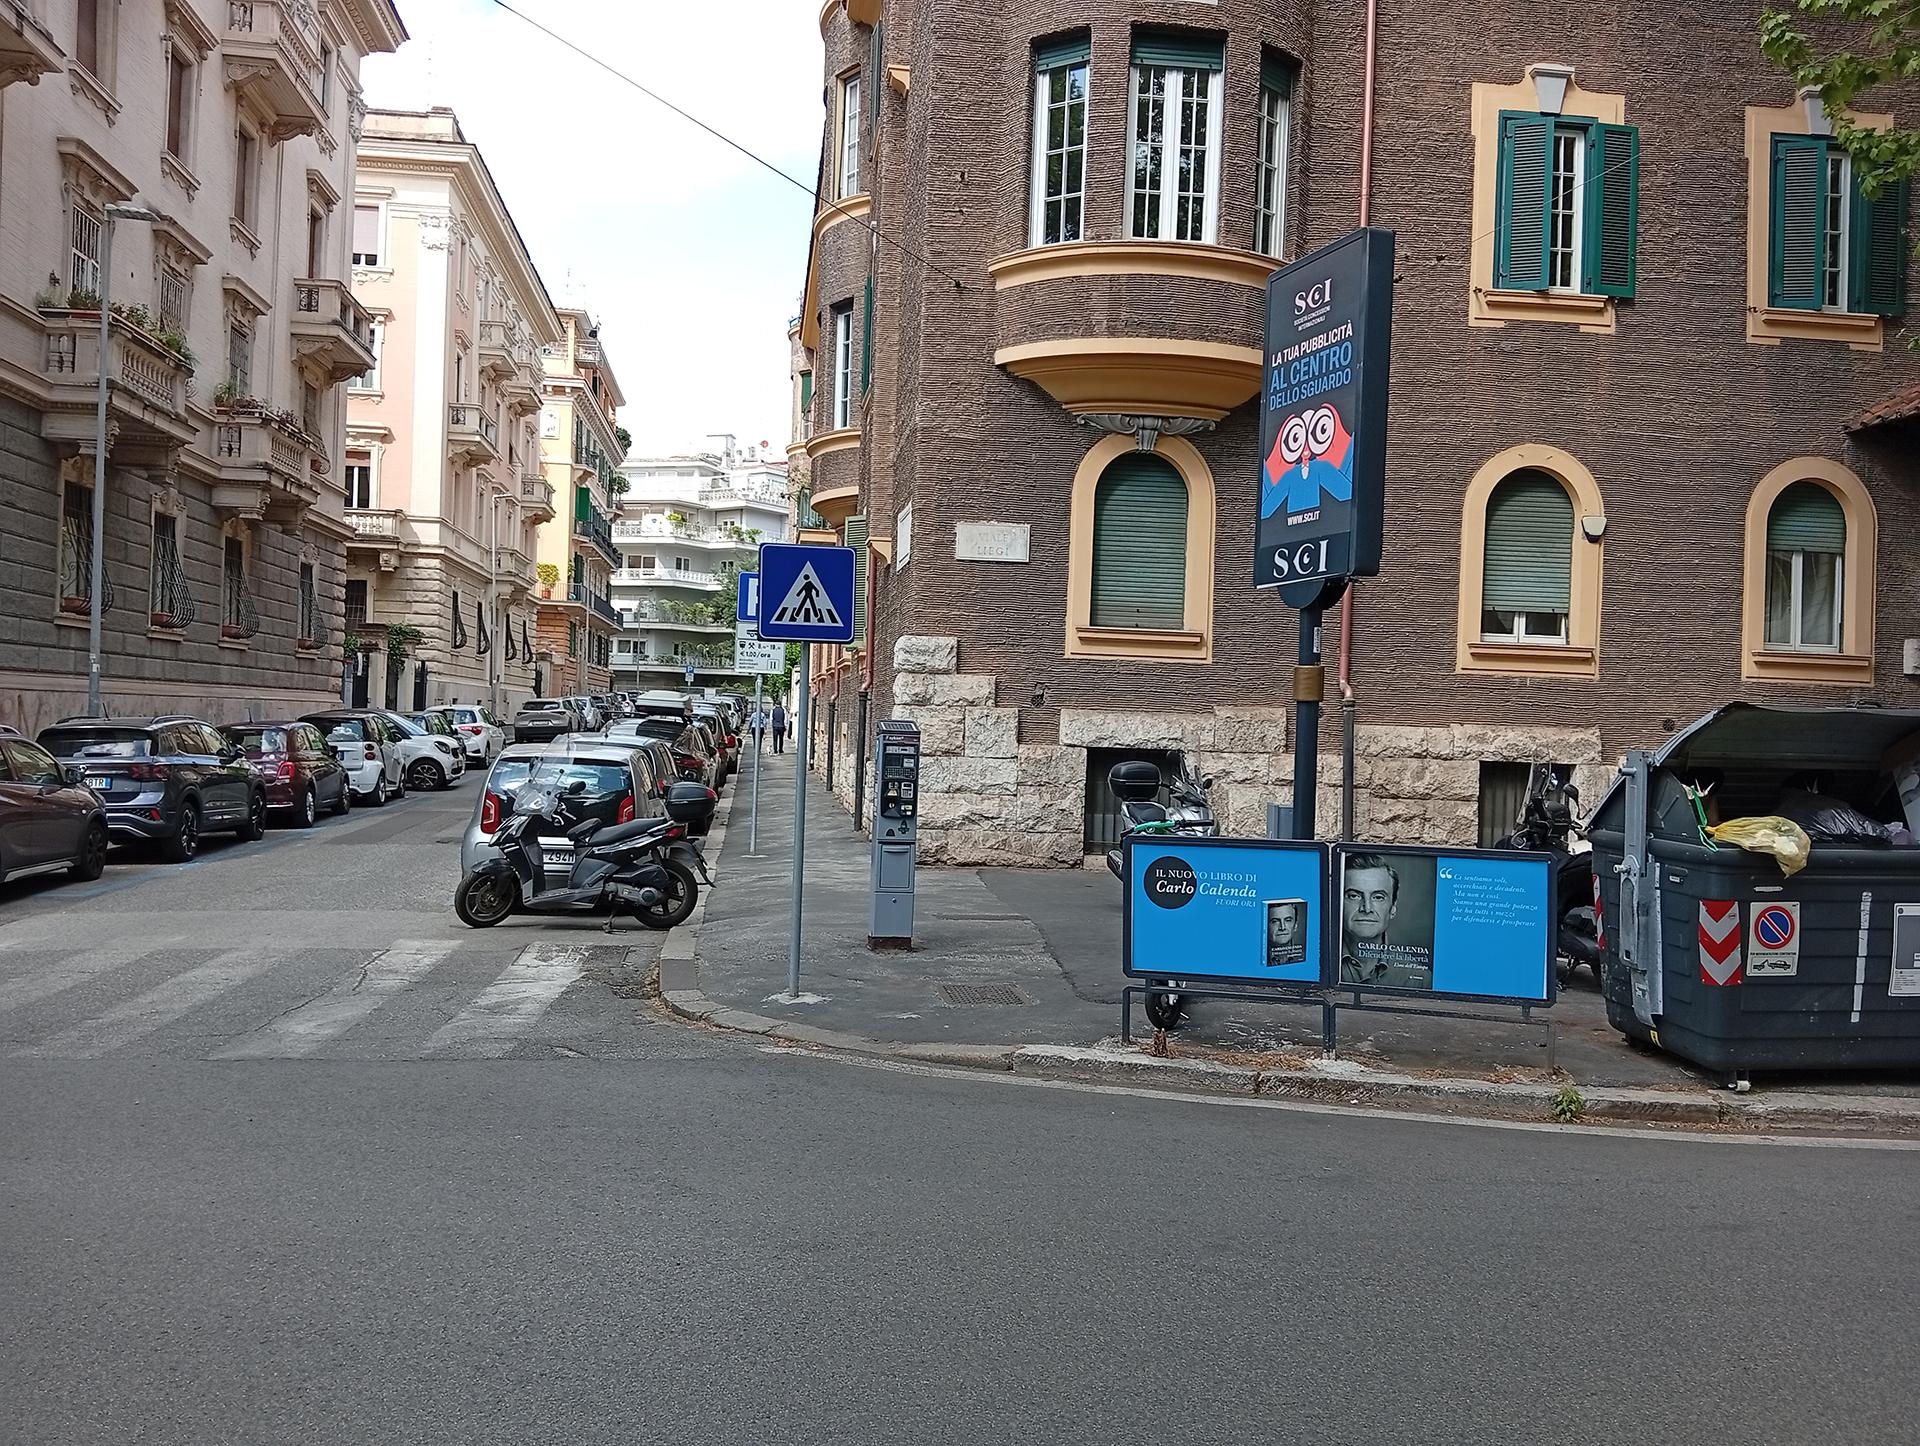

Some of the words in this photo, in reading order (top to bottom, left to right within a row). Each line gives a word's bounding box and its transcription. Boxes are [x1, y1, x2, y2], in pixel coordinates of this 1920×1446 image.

[1295, 278, 1332, 315] SCI
[1272, 352, 1282, 367] LA
[1283, 344, 1300, 363] TUA
[1300, 320, 1353, 356] PUBBLICITÀ
[1270, 367, 1288, 393] AL
[1290, 341, 1352, 385] CENTRO
[1270, 387, 1300, 411] DELLO
[1300, 367, 1352, 400] SGUARDO
[1273, 539, 1329, 578] SCI
[1156, 869, 1166, 878] IL
[1168, 869, 1207, 880] NUOVO
[1210, 871, 1243, 882] LIBRO
[1245, 873, 1257, 883] DI
[1156, 880, 1194, 895] Carlo
[1199, 882, 1257, 898] Calenda
[1216, 898, 1239, 907] FUORI
[1240, 899, 1257, 908] ORA
[1489, 901, 1511, 909] grande
[1512, 902, 1538, 911] potenza
[1358, 942, 1388, 951] CARLO
[1389, 944, 1429, 955] CALENDA
[1358, 949, 1394, 960] Difendere
[1396, 952, 1403, 961] la
[1404, 953, 1429, 963] libertà
